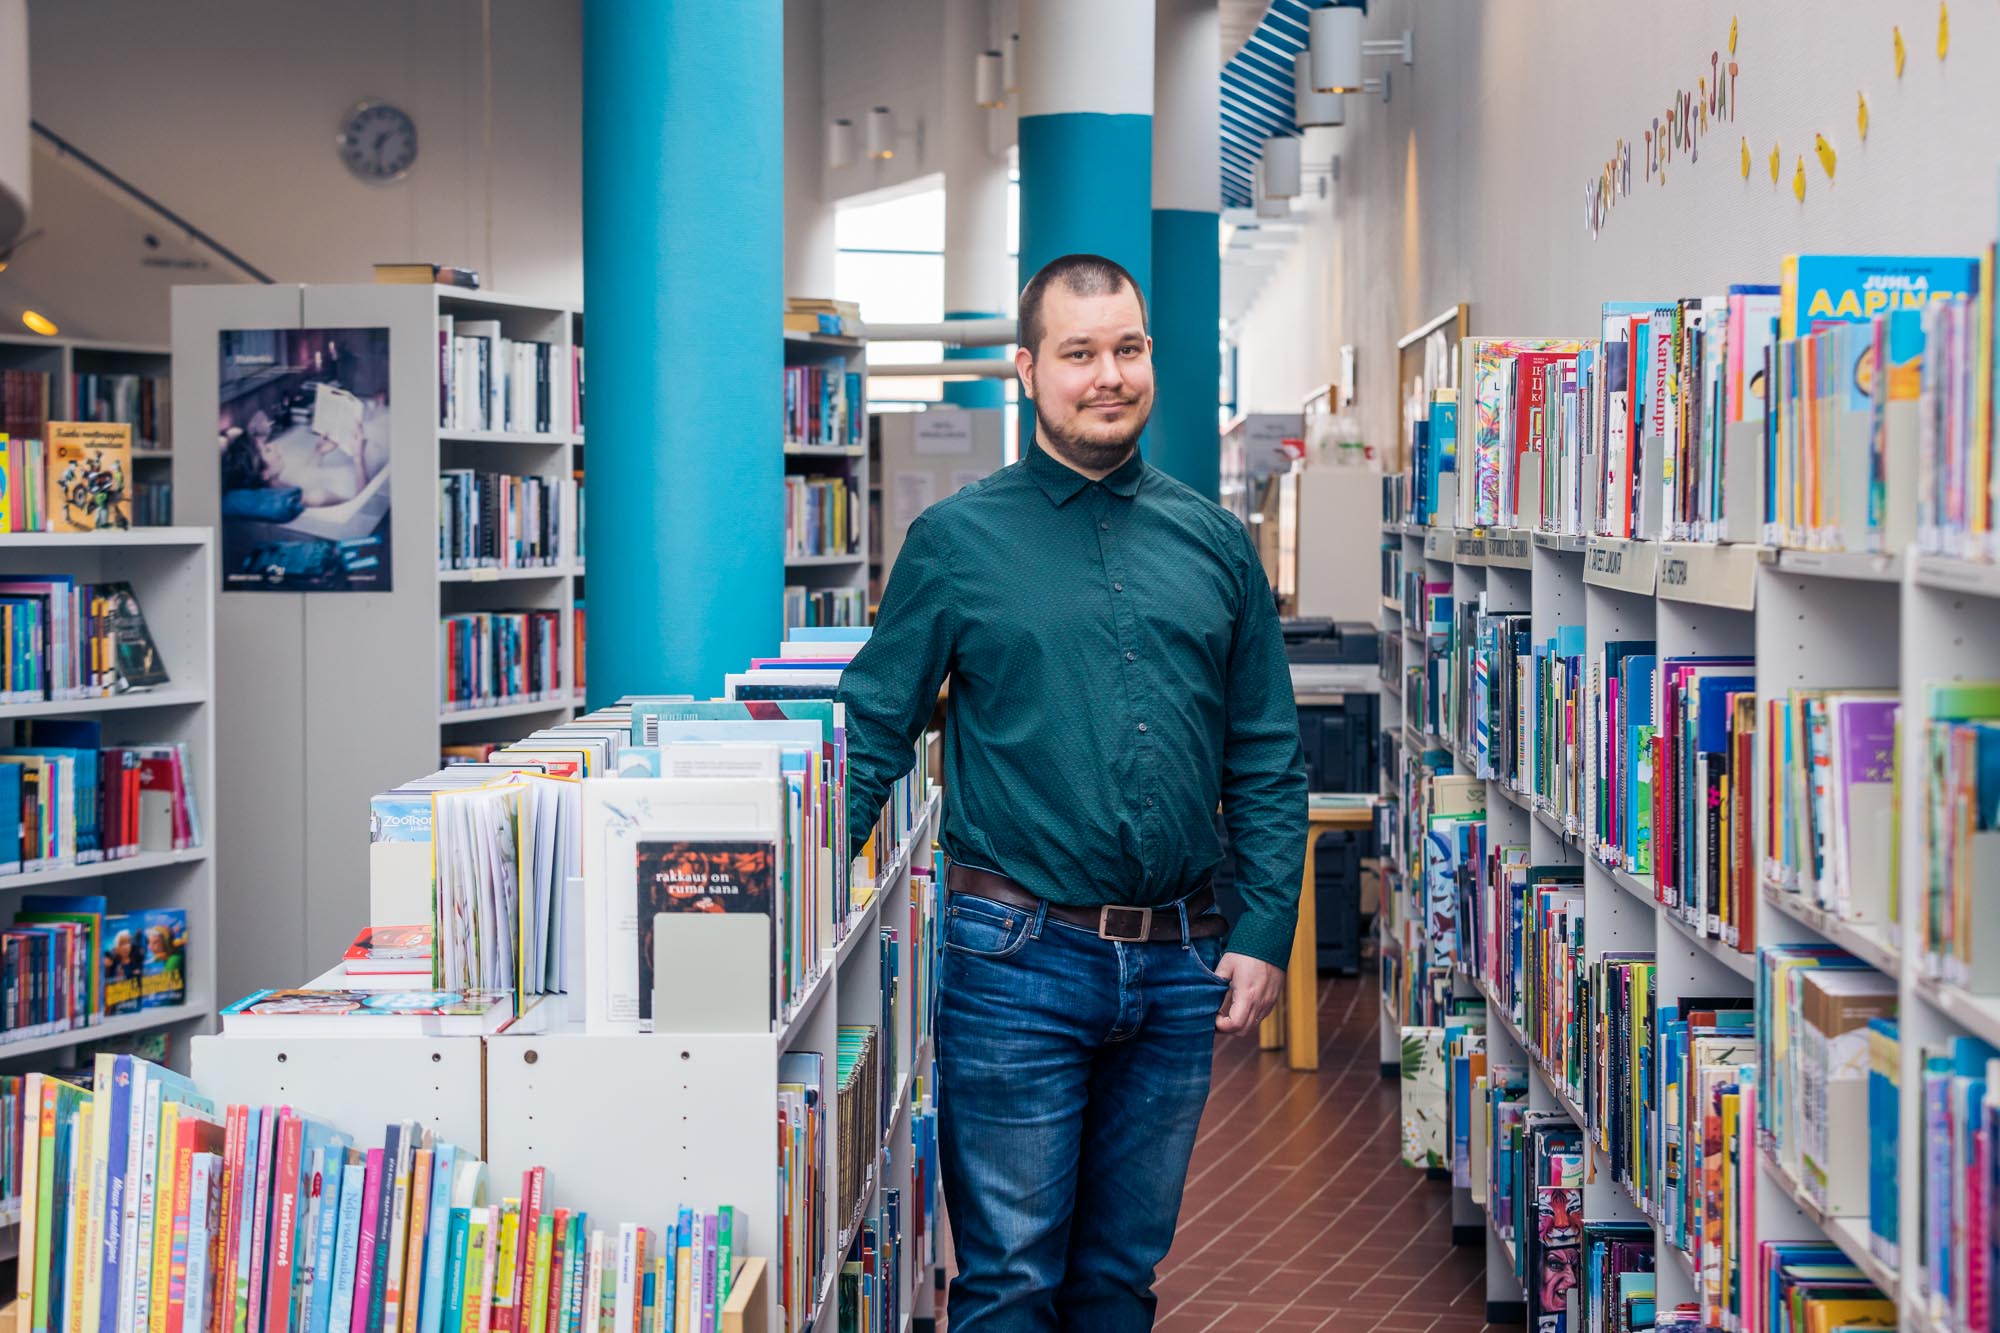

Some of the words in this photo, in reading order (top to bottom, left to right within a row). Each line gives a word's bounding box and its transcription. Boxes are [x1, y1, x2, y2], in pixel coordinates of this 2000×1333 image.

[1863, 275, 1929, 290] JUHLA
[1808, 289, 1968, 317] AAPIN
[655, 869, 707, 882] rakkaus
[711, 873, 730, 883] on
[668, 885, 704, 895] ruma
[708, 885, 739, 895] sana
[343, 1191, 359, 1221] Neljä
[277, 1193, 293, 1267] Merirosvot
[337, 1222, 354, 1291] vuodenaikaa
